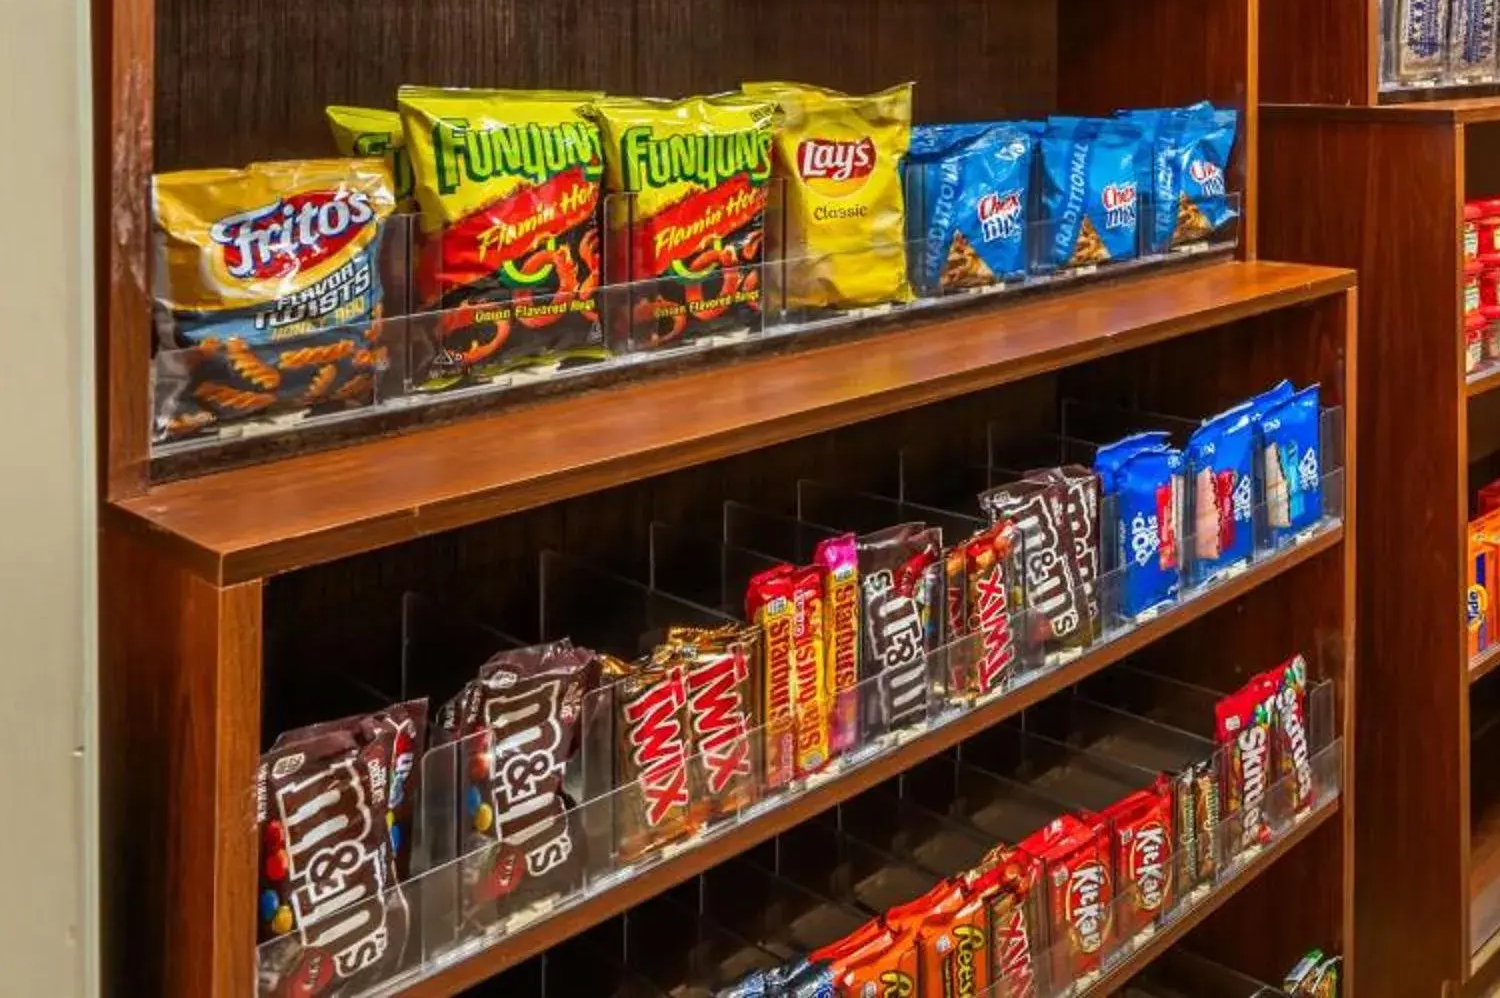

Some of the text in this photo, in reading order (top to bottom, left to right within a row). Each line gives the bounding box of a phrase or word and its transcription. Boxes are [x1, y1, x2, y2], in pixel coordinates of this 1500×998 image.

[802, 140, 873, 181] Lay's
[813, 204, 869, 221] Classic
[252, 265, 373, 331] TWISTS
[276, 258, 357, 308] FLAVOR
[976, 562, 1014, 695] TWIX
[623, 664, 689, 826] TWIX
[684, 641, 752, 794] TWIX
